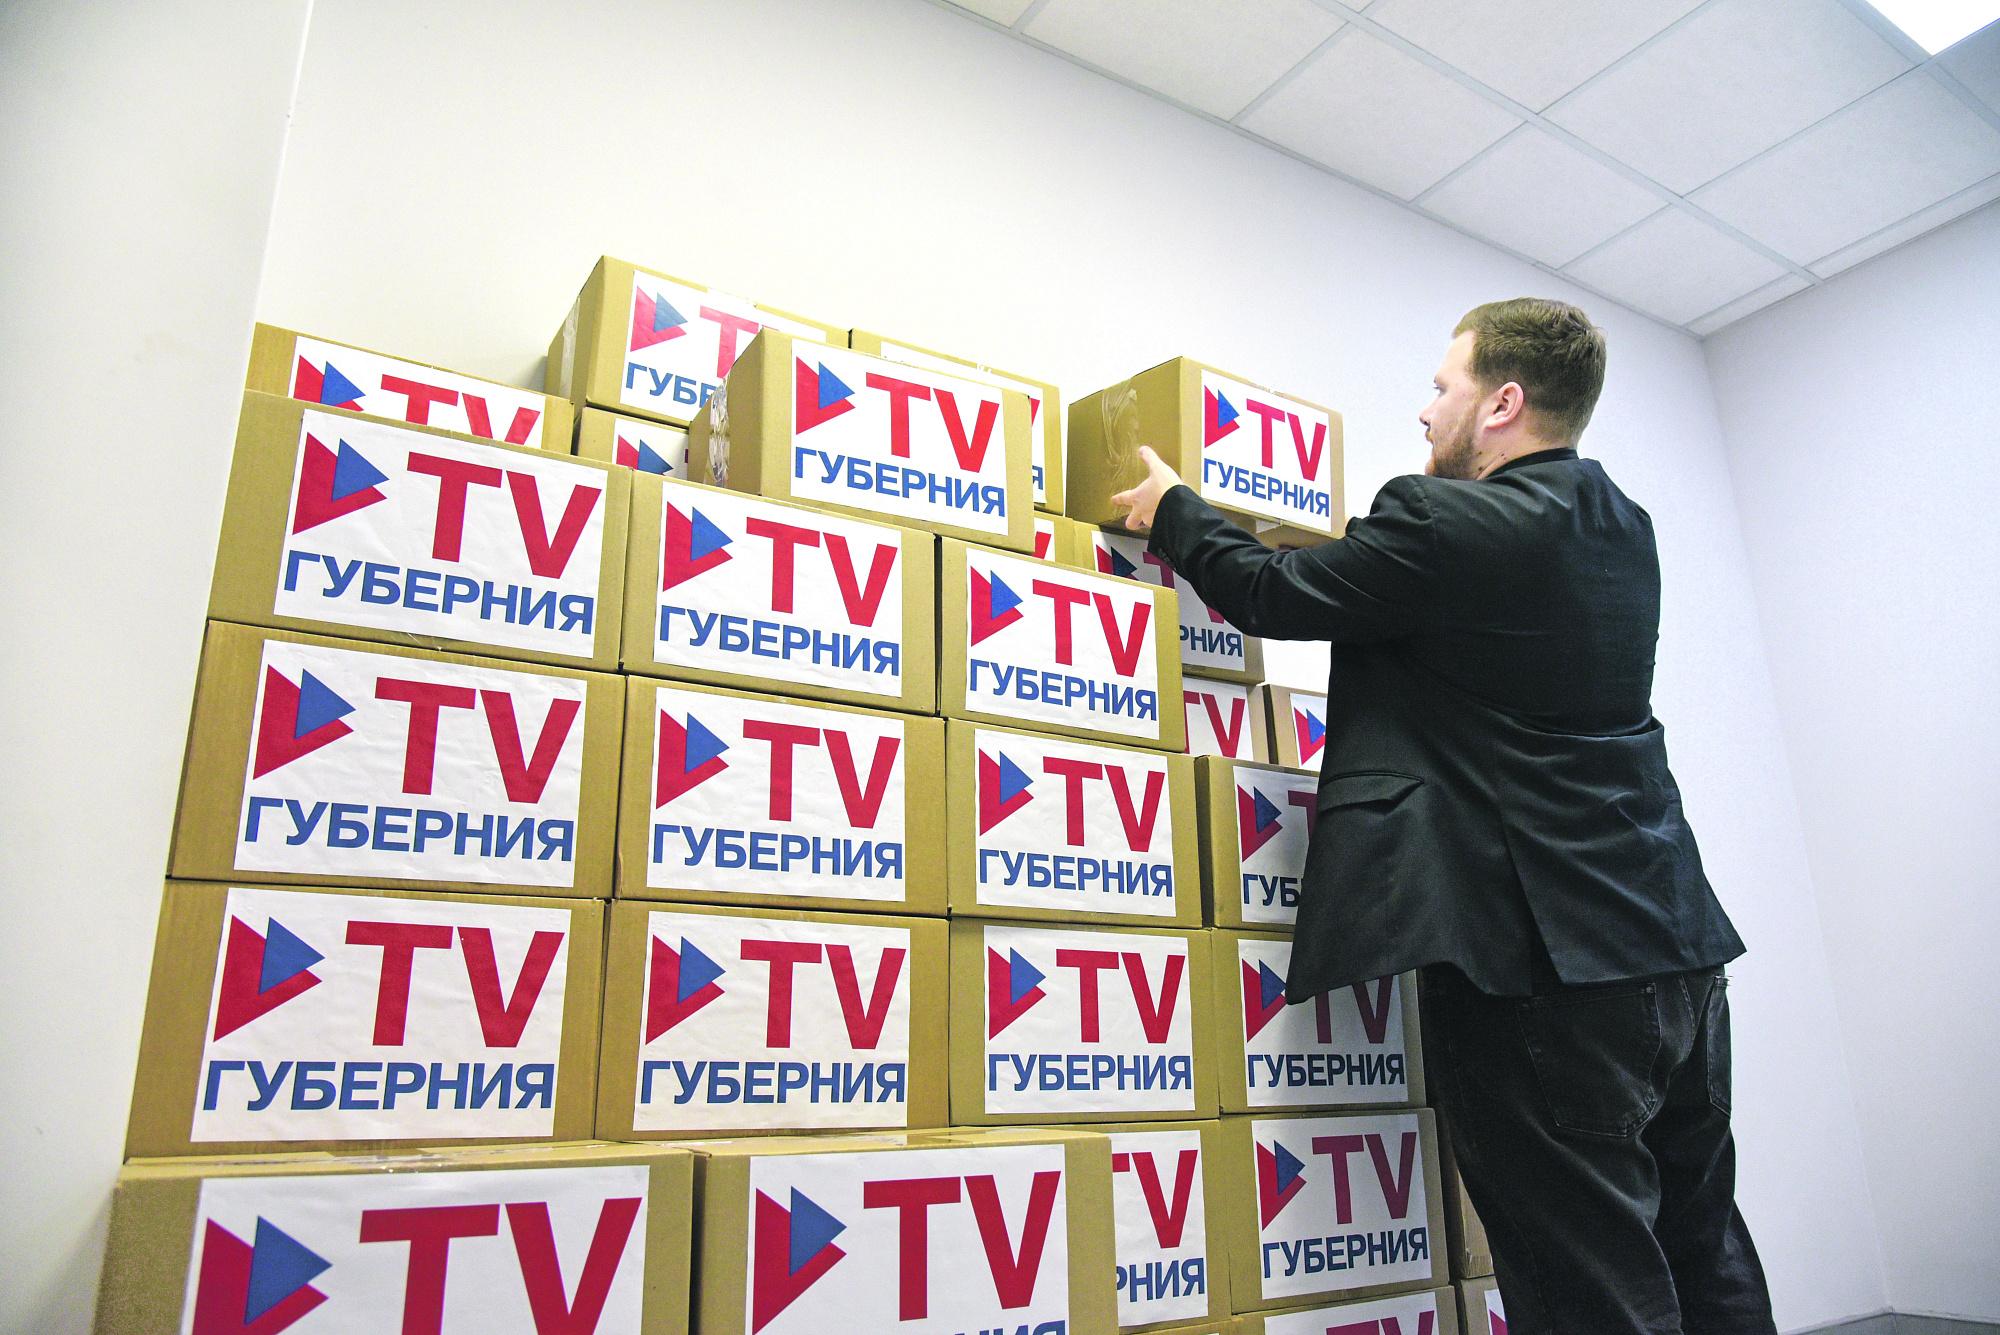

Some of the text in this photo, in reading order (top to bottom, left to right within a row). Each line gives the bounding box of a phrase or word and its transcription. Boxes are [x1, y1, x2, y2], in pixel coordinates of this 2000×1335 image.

[866, 372, 999, 473] TV
[1246, 398, 1327, 482] TV
[406, 451, 602, 580] TV
[795, 446, 1006, 518] ГУБЕРНИЯ
[1203, 458, 1330, 518] ГУБЕРНИЯ
[283, 550, 595, 635] ГУБЕРНИЯ
[746, 516, 898, 628] TV
[659, 604, 900, 677] ГУБЕРНИЯ
[1032, 578, 1152, 678] TV
[968, 658, 1158, 721] ГУБЕРНИЯ
[374, 676, 581, 804] TV
[742, 718, 901, 830] TV
[245, 796, 575, 862] ГУБЕРНИЯ
[1042, 755, 1166, 853] TV
[653, 823, 904, 880] ГУБЕРНИЯ
[978, 848, 1174, 899] ГУБЕРНИЯ
[346, 920, 565, 1049] TV
[740, 938, 907, 1050] TV
[1055, 948, 1186, 1044] TV
[203, 1060, 555, 1111] ГУБЕРНИЯ
[640, 1060, 906, 1105] ГУБЕРНИЯ
[988, 1053, 1192, 1092] ГУБЕРНИЯ
[1247, 1053, 1405, 1088] ГУБЕРНИЯ
[1312, 1131, 1417, 1225] TV
[359, 1196, 643, 1335] TV
[863, 1170, 1062, 1322] TV
[1263, 1226, 1429, 1279] ГУБЕРНИЯ
